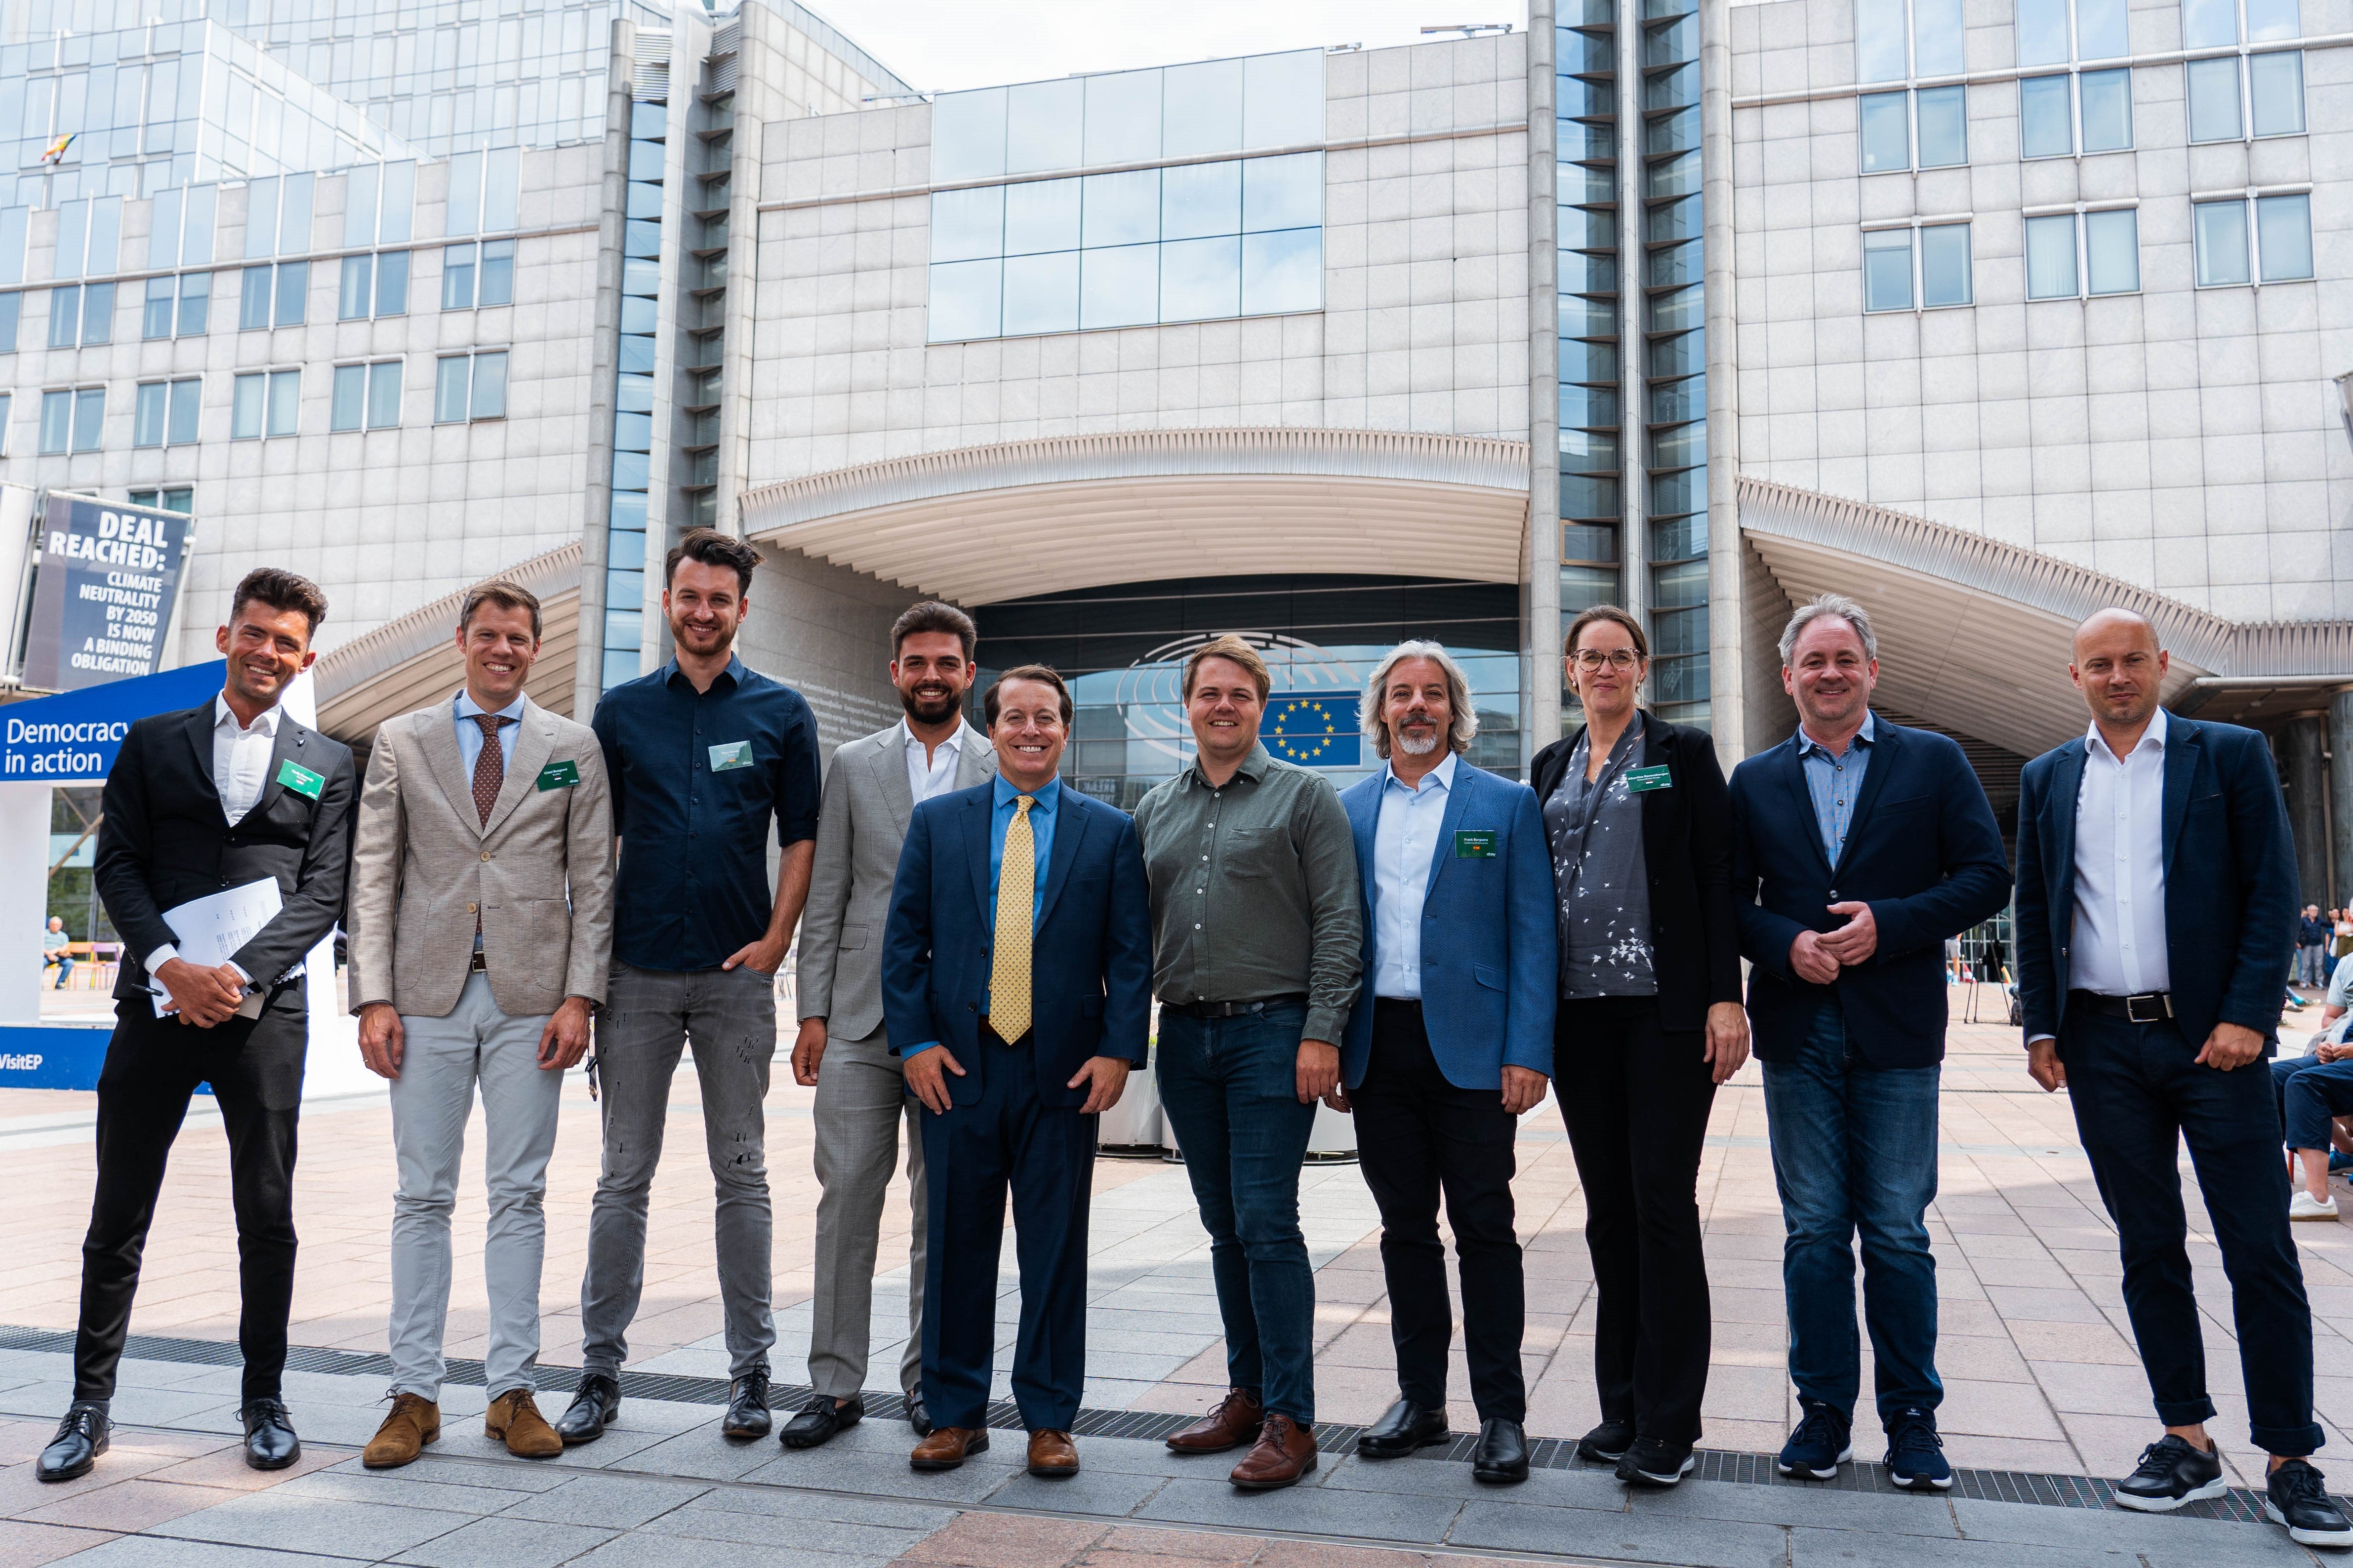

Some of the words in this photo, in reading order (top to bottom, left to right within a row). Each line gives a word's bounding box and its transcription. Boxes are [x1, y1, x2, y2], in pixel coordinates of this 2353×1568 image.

[99, 511, 167, 548] DEAL
[48, 531, 165, 571] REACHED:
[107, 571, 163, 593] CLIMATE
[79, 584, 161, 608] NEUTRALITY
[106, 606, 126, 621] BY
[126, 609, 158, 626] 2050
[107, 623, 120, 637] IS
[122, 625, 156, 642] NOW
[83, 637, 94, 651] A
[96, 639, 152, 659] BINDING
[71, 652, 150, 676] OBLIGATION
[5, 748, 25, 773] in
[31, 747, 102, 773] action
